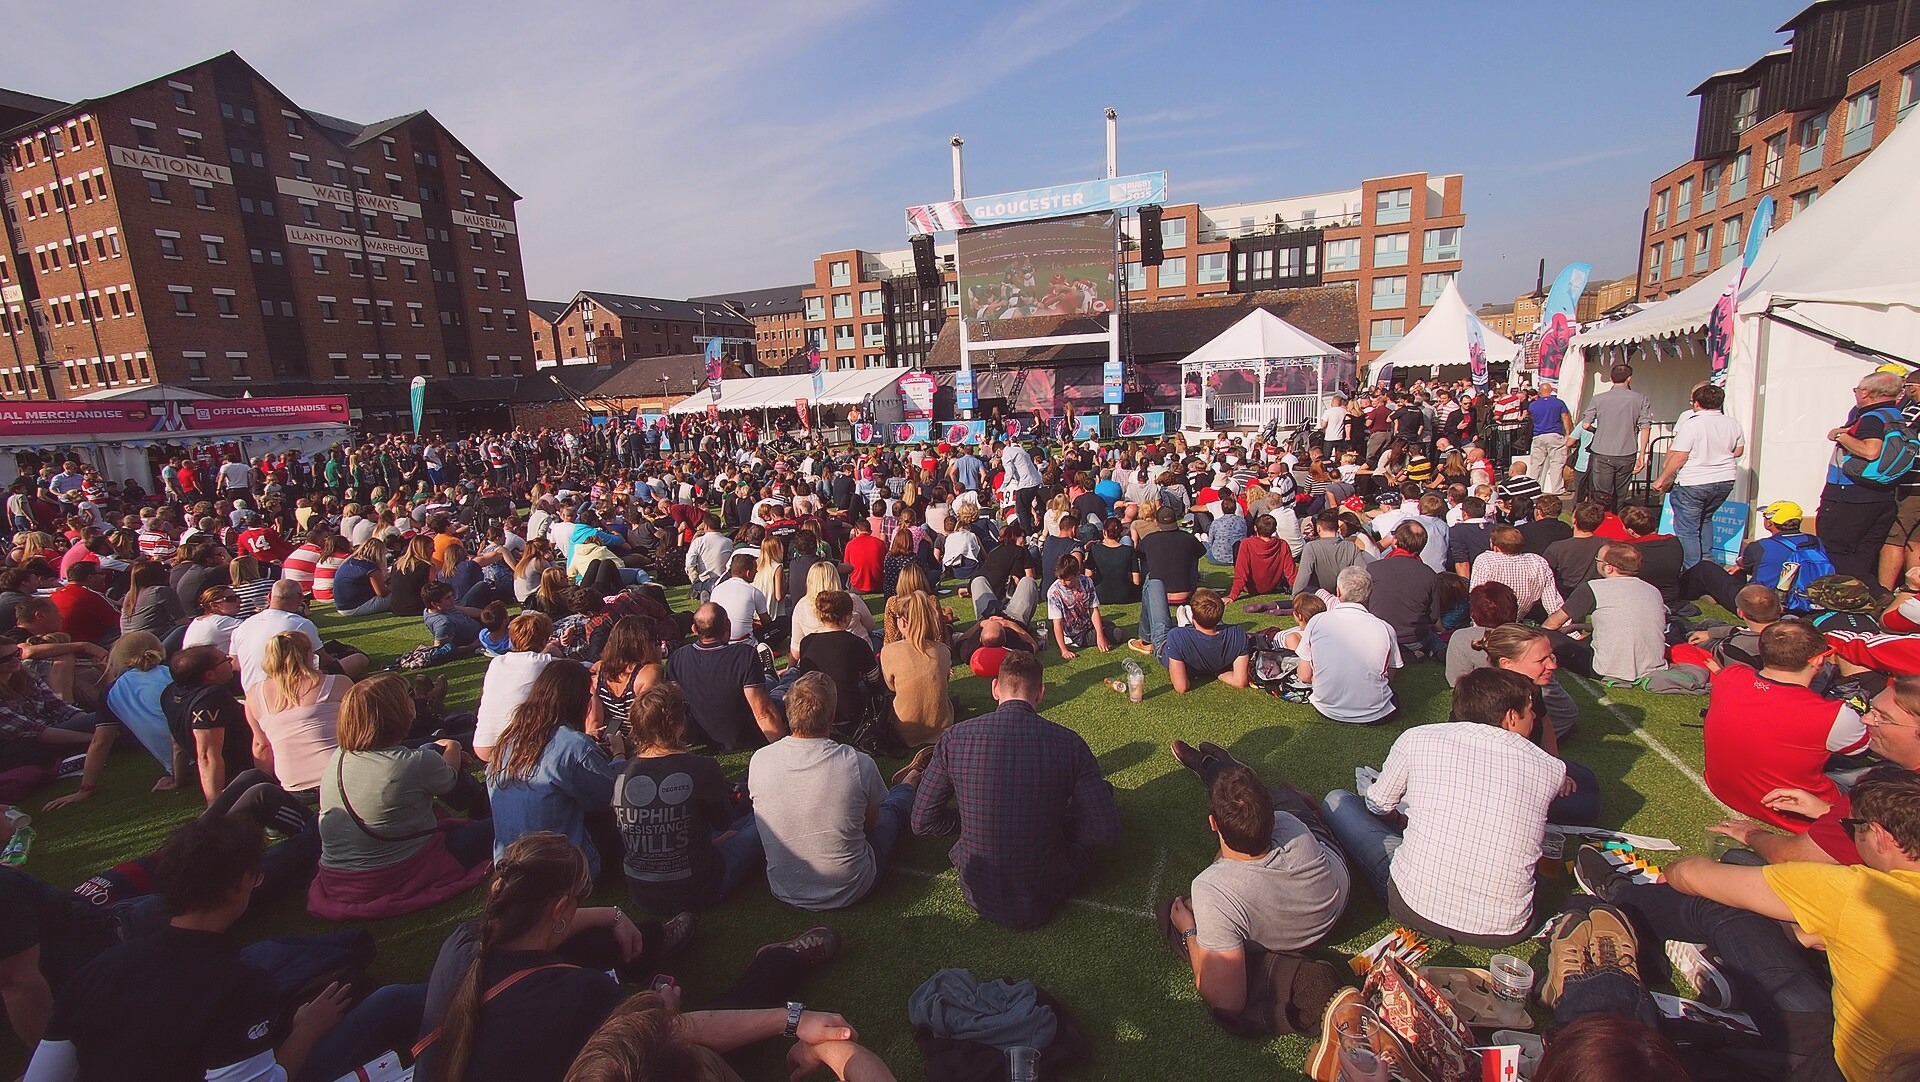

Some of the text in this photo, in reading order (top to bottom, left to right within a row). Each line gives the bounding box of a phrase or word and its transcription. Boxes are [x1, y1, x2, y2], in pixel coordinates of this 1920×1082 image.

[121, 150, 225, 181] NATIONAL
[1127, 179, 1152, 189] RUGBY
[312, 185, 399, 211] WATERWAYS
[975, 192, 1084, 218] GLOUCESTER
[463, 215, 508, 231] MUSEUM
[291, 229, 425, 257] LLANTHONY WAREHOUSE
[25, 410, 123, 419] MERCHANDISE
[213, 406, 259, 416] OFFICIAL
[261, 404, 327, 413] MERCHANDISE
[1713, 515, 1744, 525] UIETLY
[1717, 526, 1735, 535] THE
[247, 535, 271, 553] 14
[192, 709, 220, 723] XV
[627, 805, 692, 824] UPHILL
[623, 821, 690, 835] RESISTANCE
[623, 830, 689, 853] WILLS
